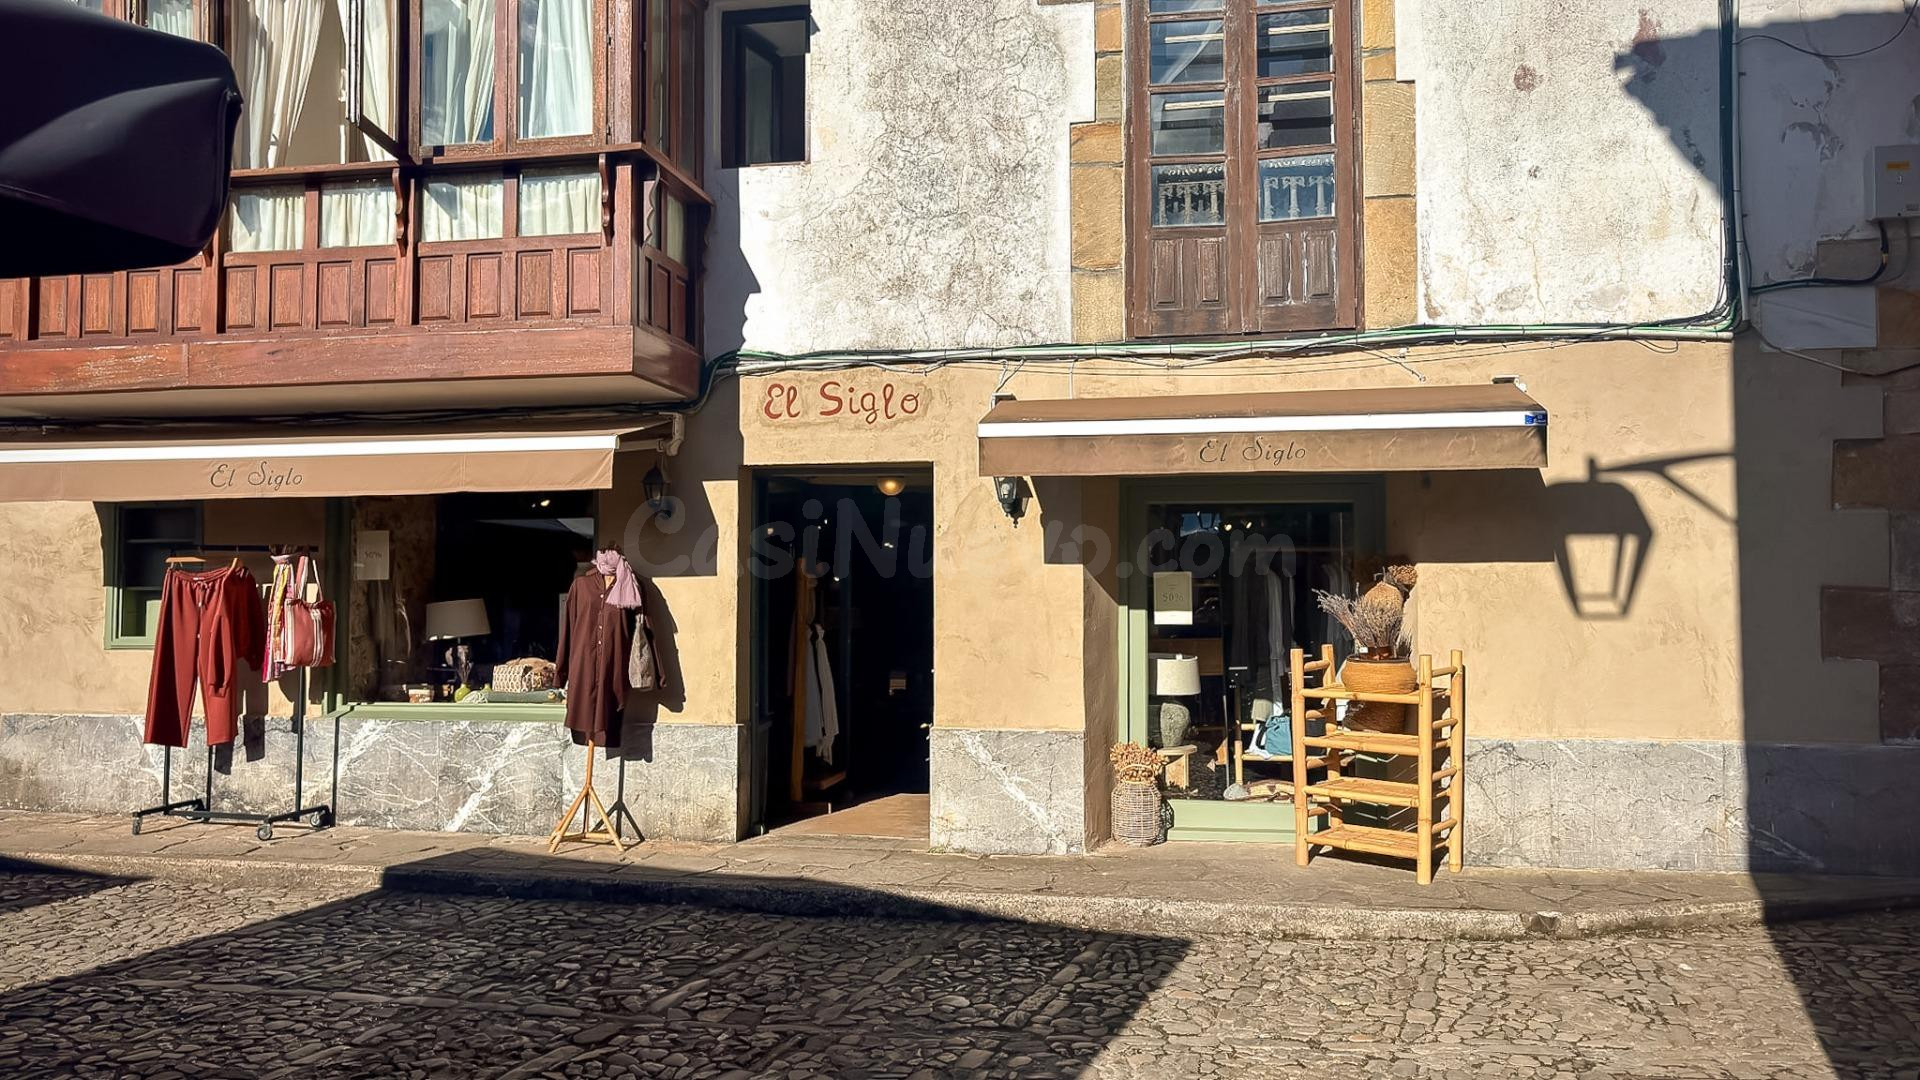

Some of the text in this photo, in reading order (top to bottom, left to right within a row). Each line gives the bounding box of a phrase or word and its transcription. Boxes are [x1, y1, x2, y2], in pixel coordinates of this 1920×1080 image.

[764, 381, 920, 424] El Siglo
[1199, 436, 1306, 465] El Siglo
[210, 460, 303, 491] El Siglo
